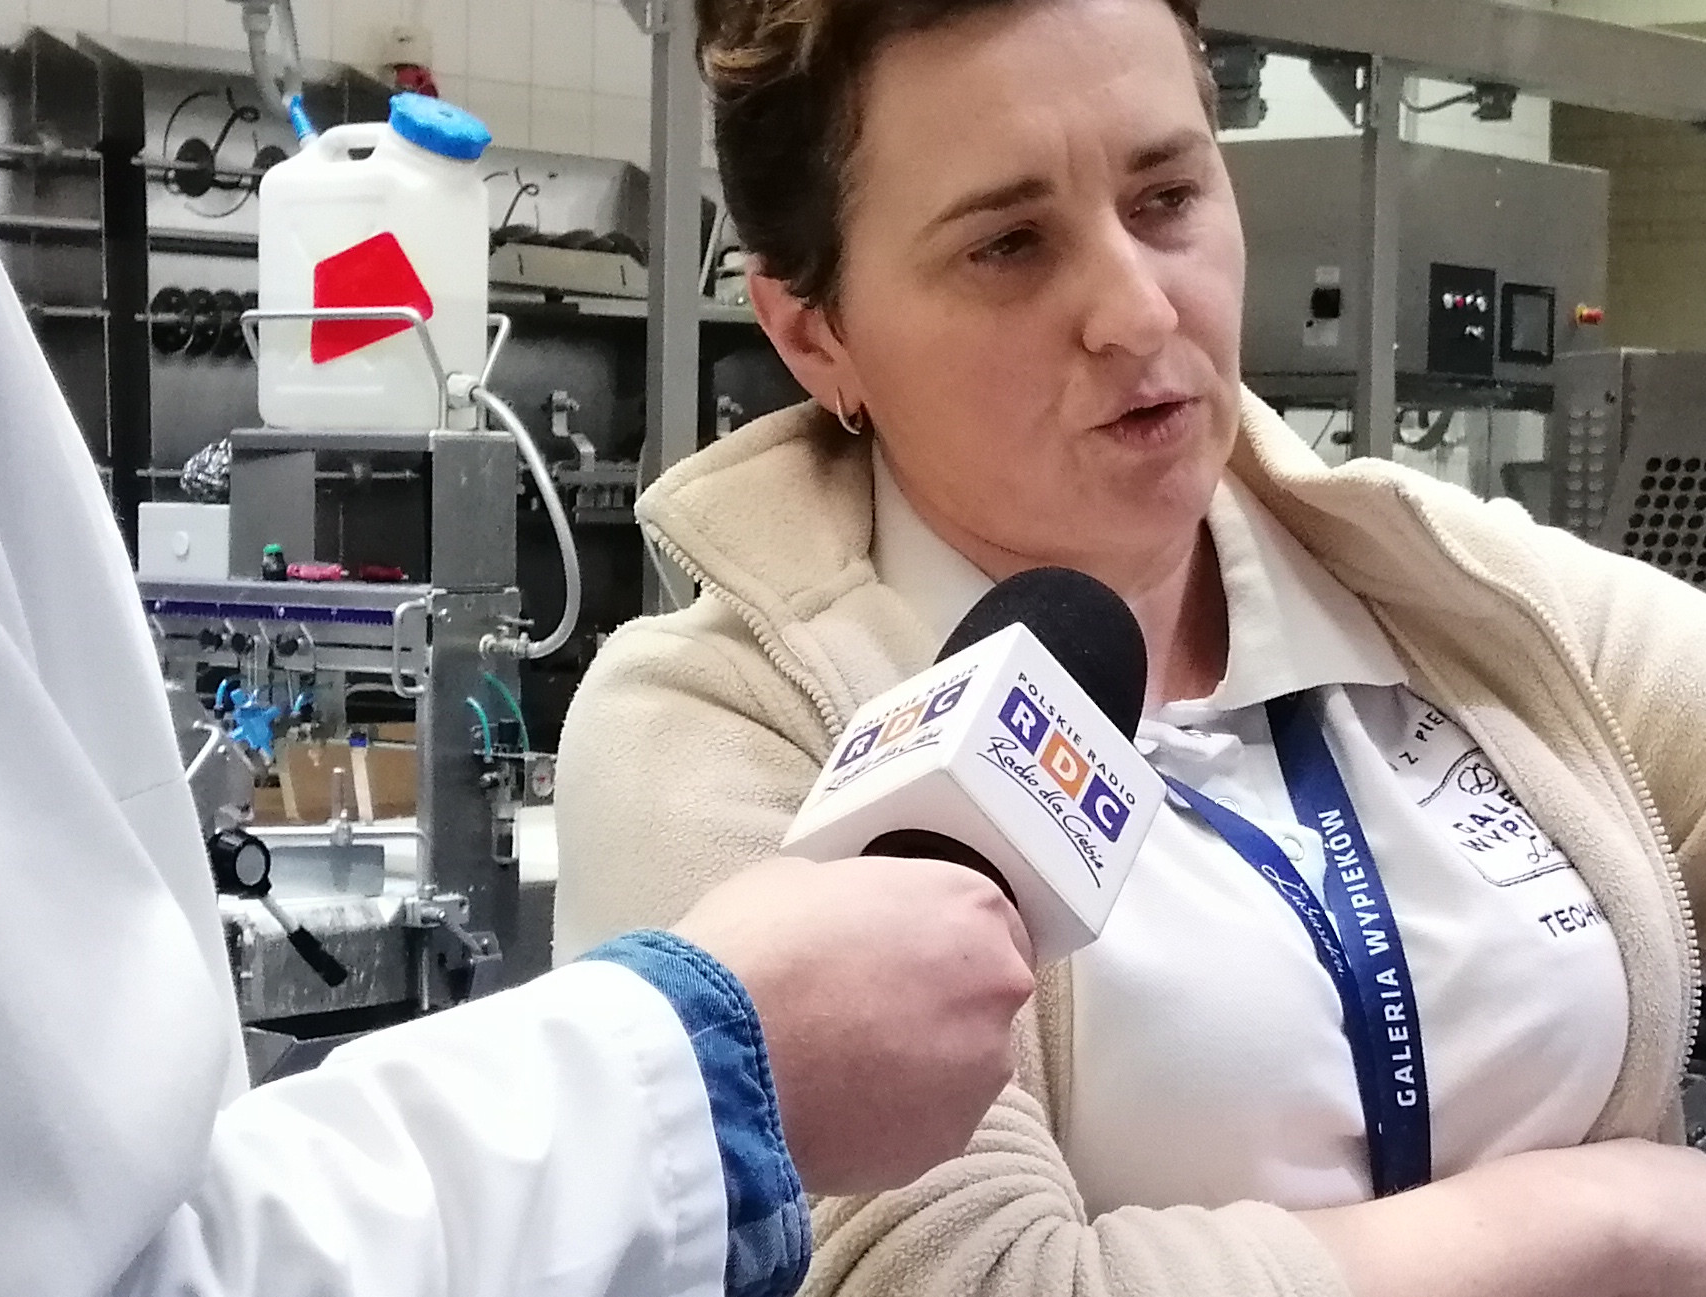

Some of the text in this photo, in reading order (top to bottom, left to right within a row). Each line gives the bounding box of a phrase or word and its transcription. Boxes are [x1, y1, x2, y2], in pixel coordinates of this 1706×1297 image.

[840, 683, 966, 765] RDC
[986, 736, 1039, 787] Radio
[1038, 786, 1067, 815] dla
[1007, 696, 1123, 834] RDC
[1017, 671, 1137, 806] POLSKIE RADIO
[1317, 808, 1417, 1107] GALERIA WYPIEKÓW
